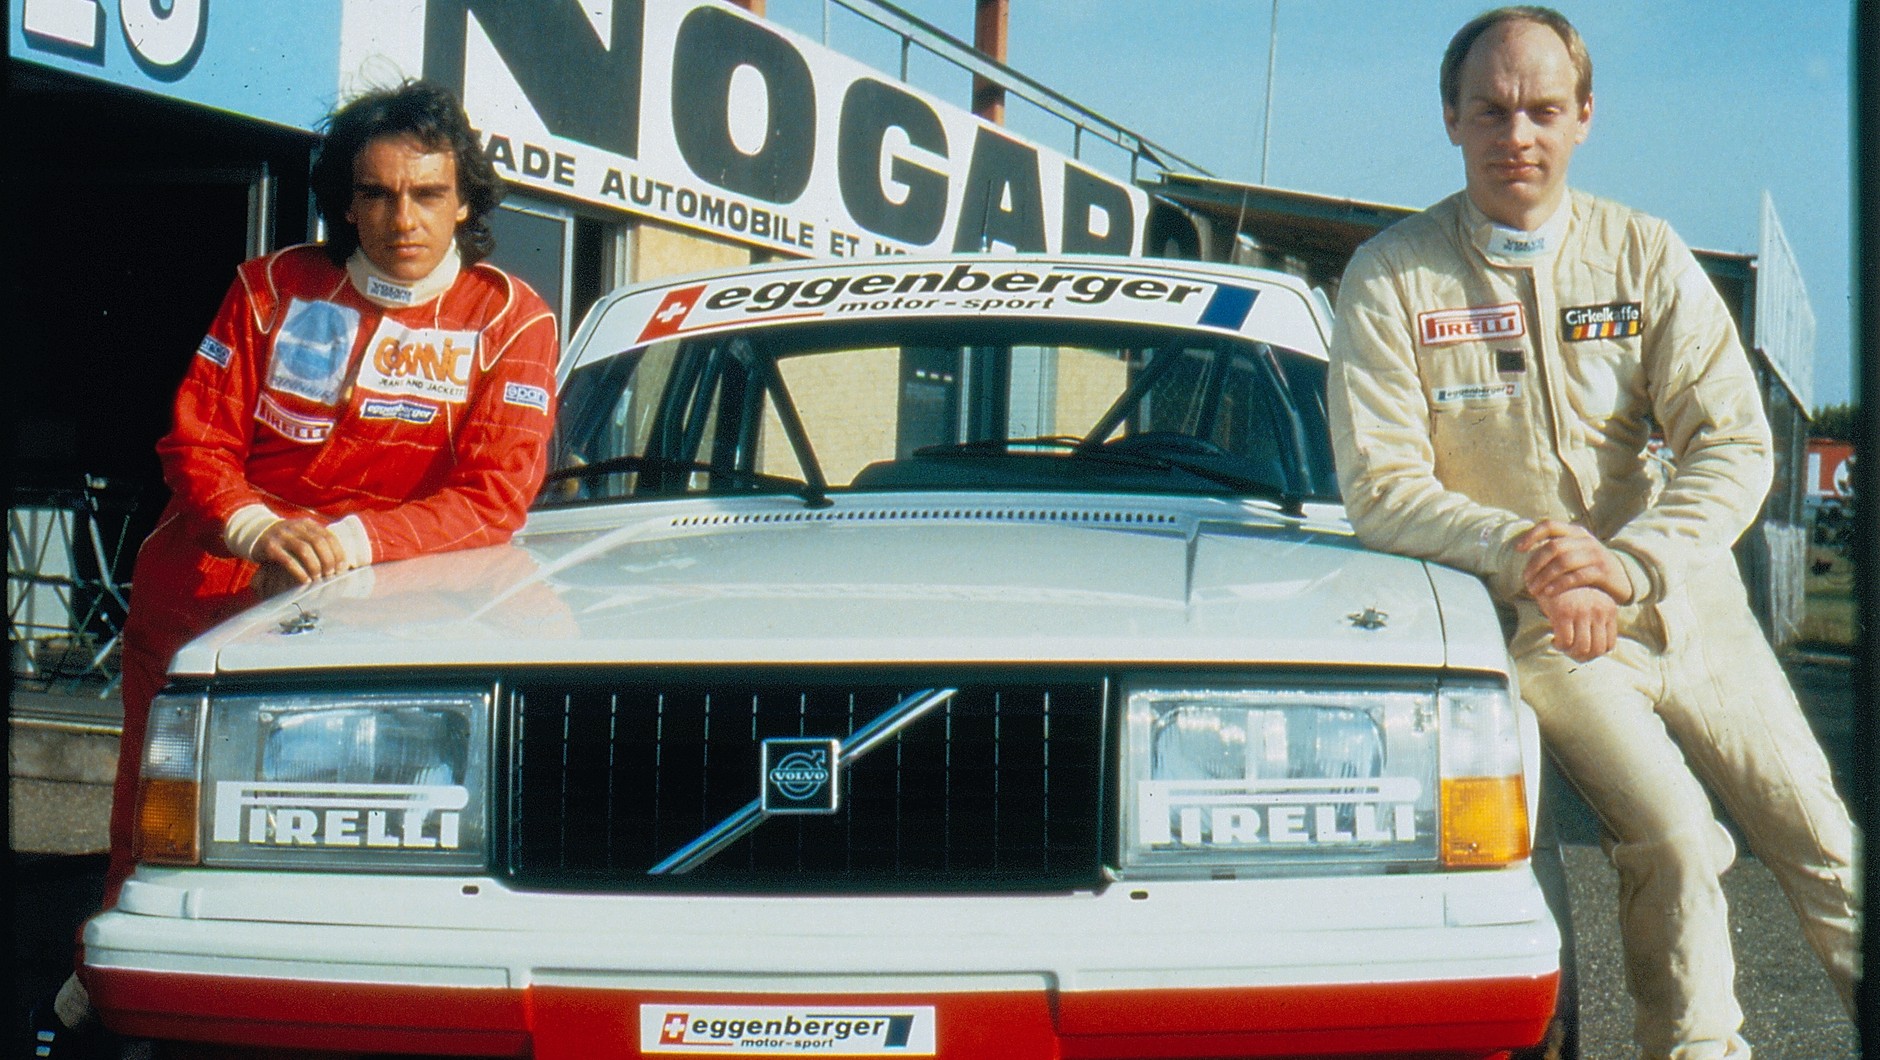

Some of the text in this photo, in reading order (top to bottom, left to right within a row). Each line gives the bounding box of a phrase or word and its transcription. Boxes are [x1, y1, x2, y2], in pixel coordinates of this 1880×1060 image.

[600, 167, 814, 249] AUTOMOBILE
[830, 229, 860, 257] ET
[705, 265, 1203, 312] eggenberger
[1426, 311, 1516, 339] PIRELLI
[1565, 306, 1639, 325] Cirkelkaffe
[259, 398, 331, 440] PIRELLI
[775, 771, 825, 781] VOLVO
[214, 781, 469, 848] PIRELLI
[1138, 777, 1422, 844] PIRELLI
[692, 1015, 884, 1039] eggenberger
[740, 1036, 834, 1049] motor-sport
